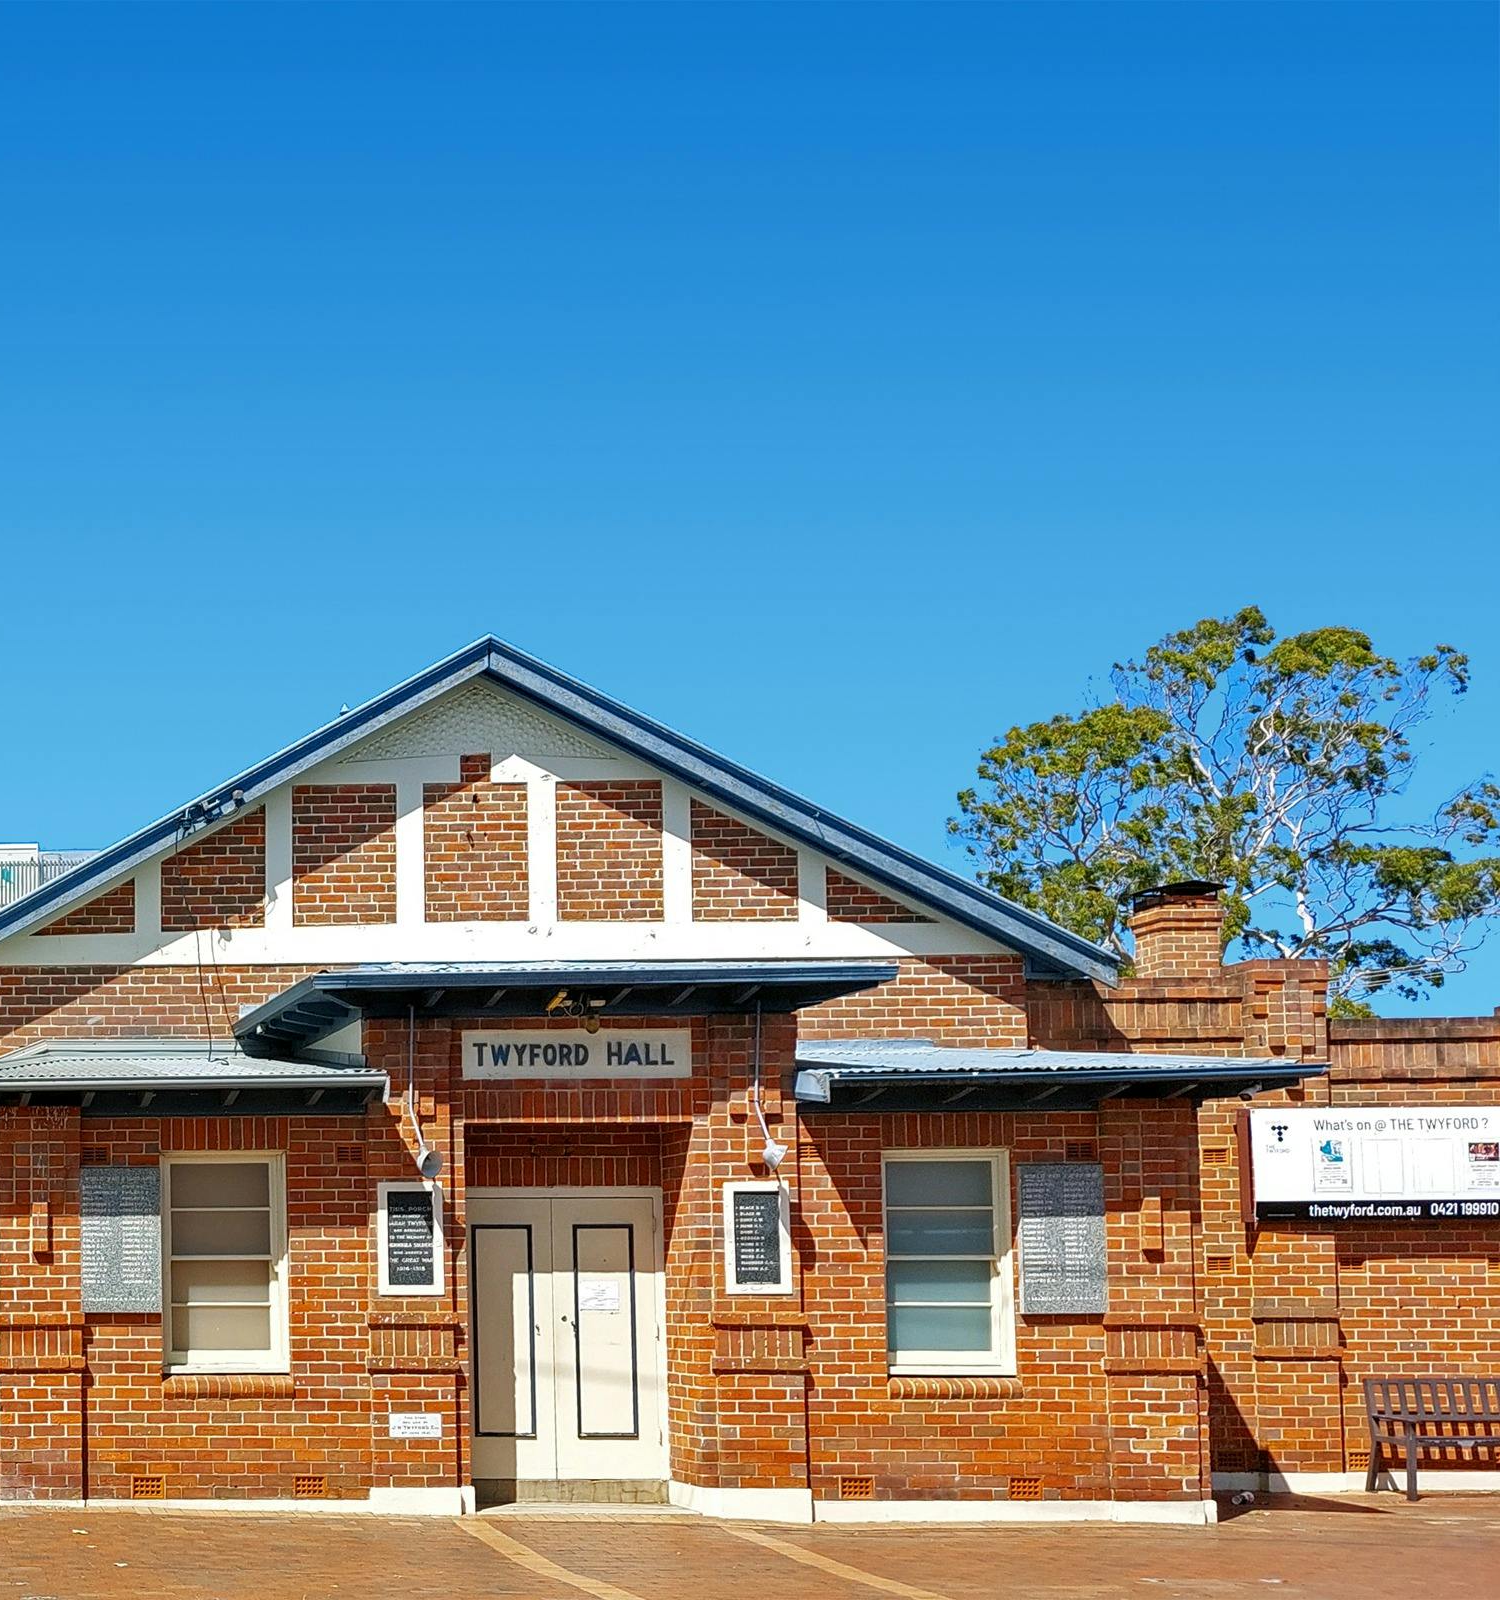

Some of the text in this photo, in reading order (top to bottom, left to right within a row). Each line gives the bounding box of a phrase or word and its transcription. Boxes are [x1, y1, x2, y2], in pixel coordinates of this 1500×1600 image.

[473, 1041, 675, 1067] TWYFORD HALL
[1313, 1119, 1353, 1131] What's
[1357, 1121, 1371, 1131] on
[1390, 1118, 1414, 1130] THE
[1417, 1117, 1479, 1130] TWYFORD
[1309, 1202, 1499, 1219] thetwyford.com.au 0421 199910
